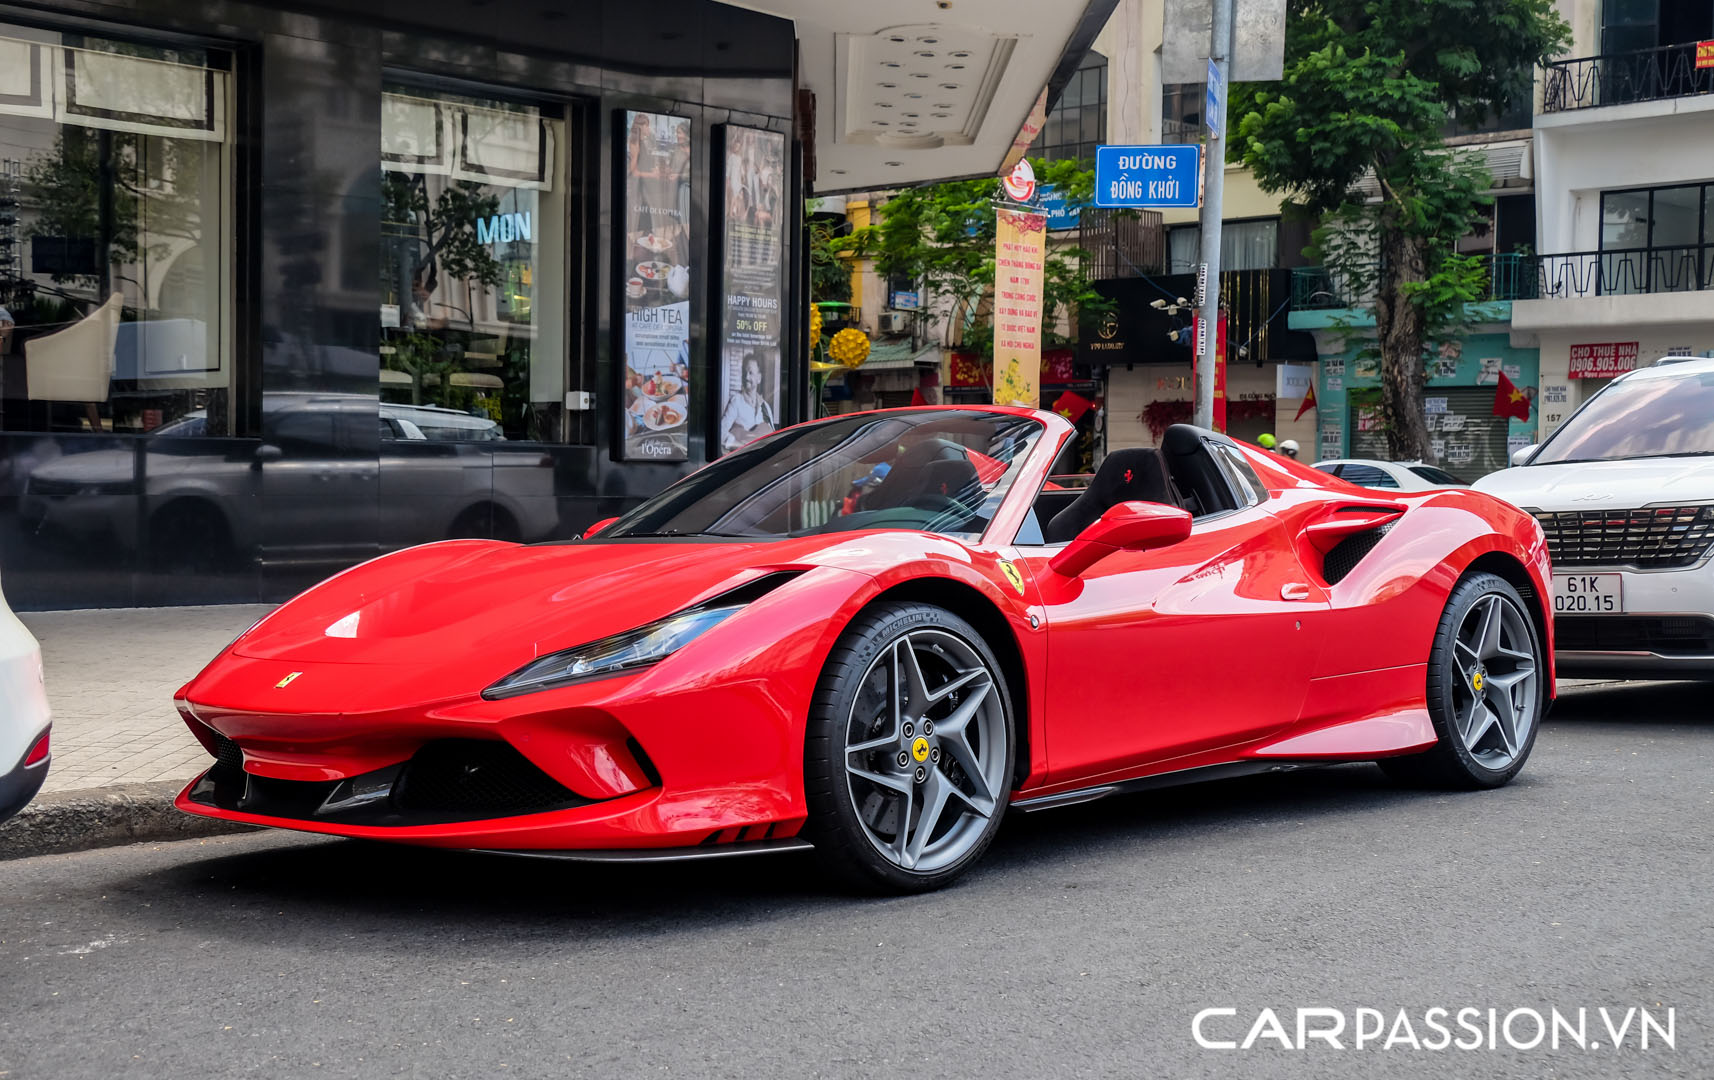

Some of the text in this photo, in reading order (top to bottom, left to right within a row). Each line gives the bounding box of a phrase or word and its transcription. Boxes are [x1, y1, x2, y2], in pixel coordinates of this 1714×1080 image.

[1118, 152, 1177, 170] ĐƯỜNG
[1110, 172, 1179, 199] ĐỒNG KHỞI
[727, 294, 750, 307] HAPPY
[752, 296, 778, 309] HOURS
[632, 304, 683, 324] HIGH TEA
[736, 319, 768, 332] 50% OFF
[1572, 342, 1637, 358] CHO THUÊ NHÀ
[1546, 414, 1561, 422] 157
[641, 443, 672, 457] l'Opéra
[1567, 576, 1599, 592] 61K
[1555, 595, 1613, 611] 020.15
[881, 614, 923, 637] MICHELIN
